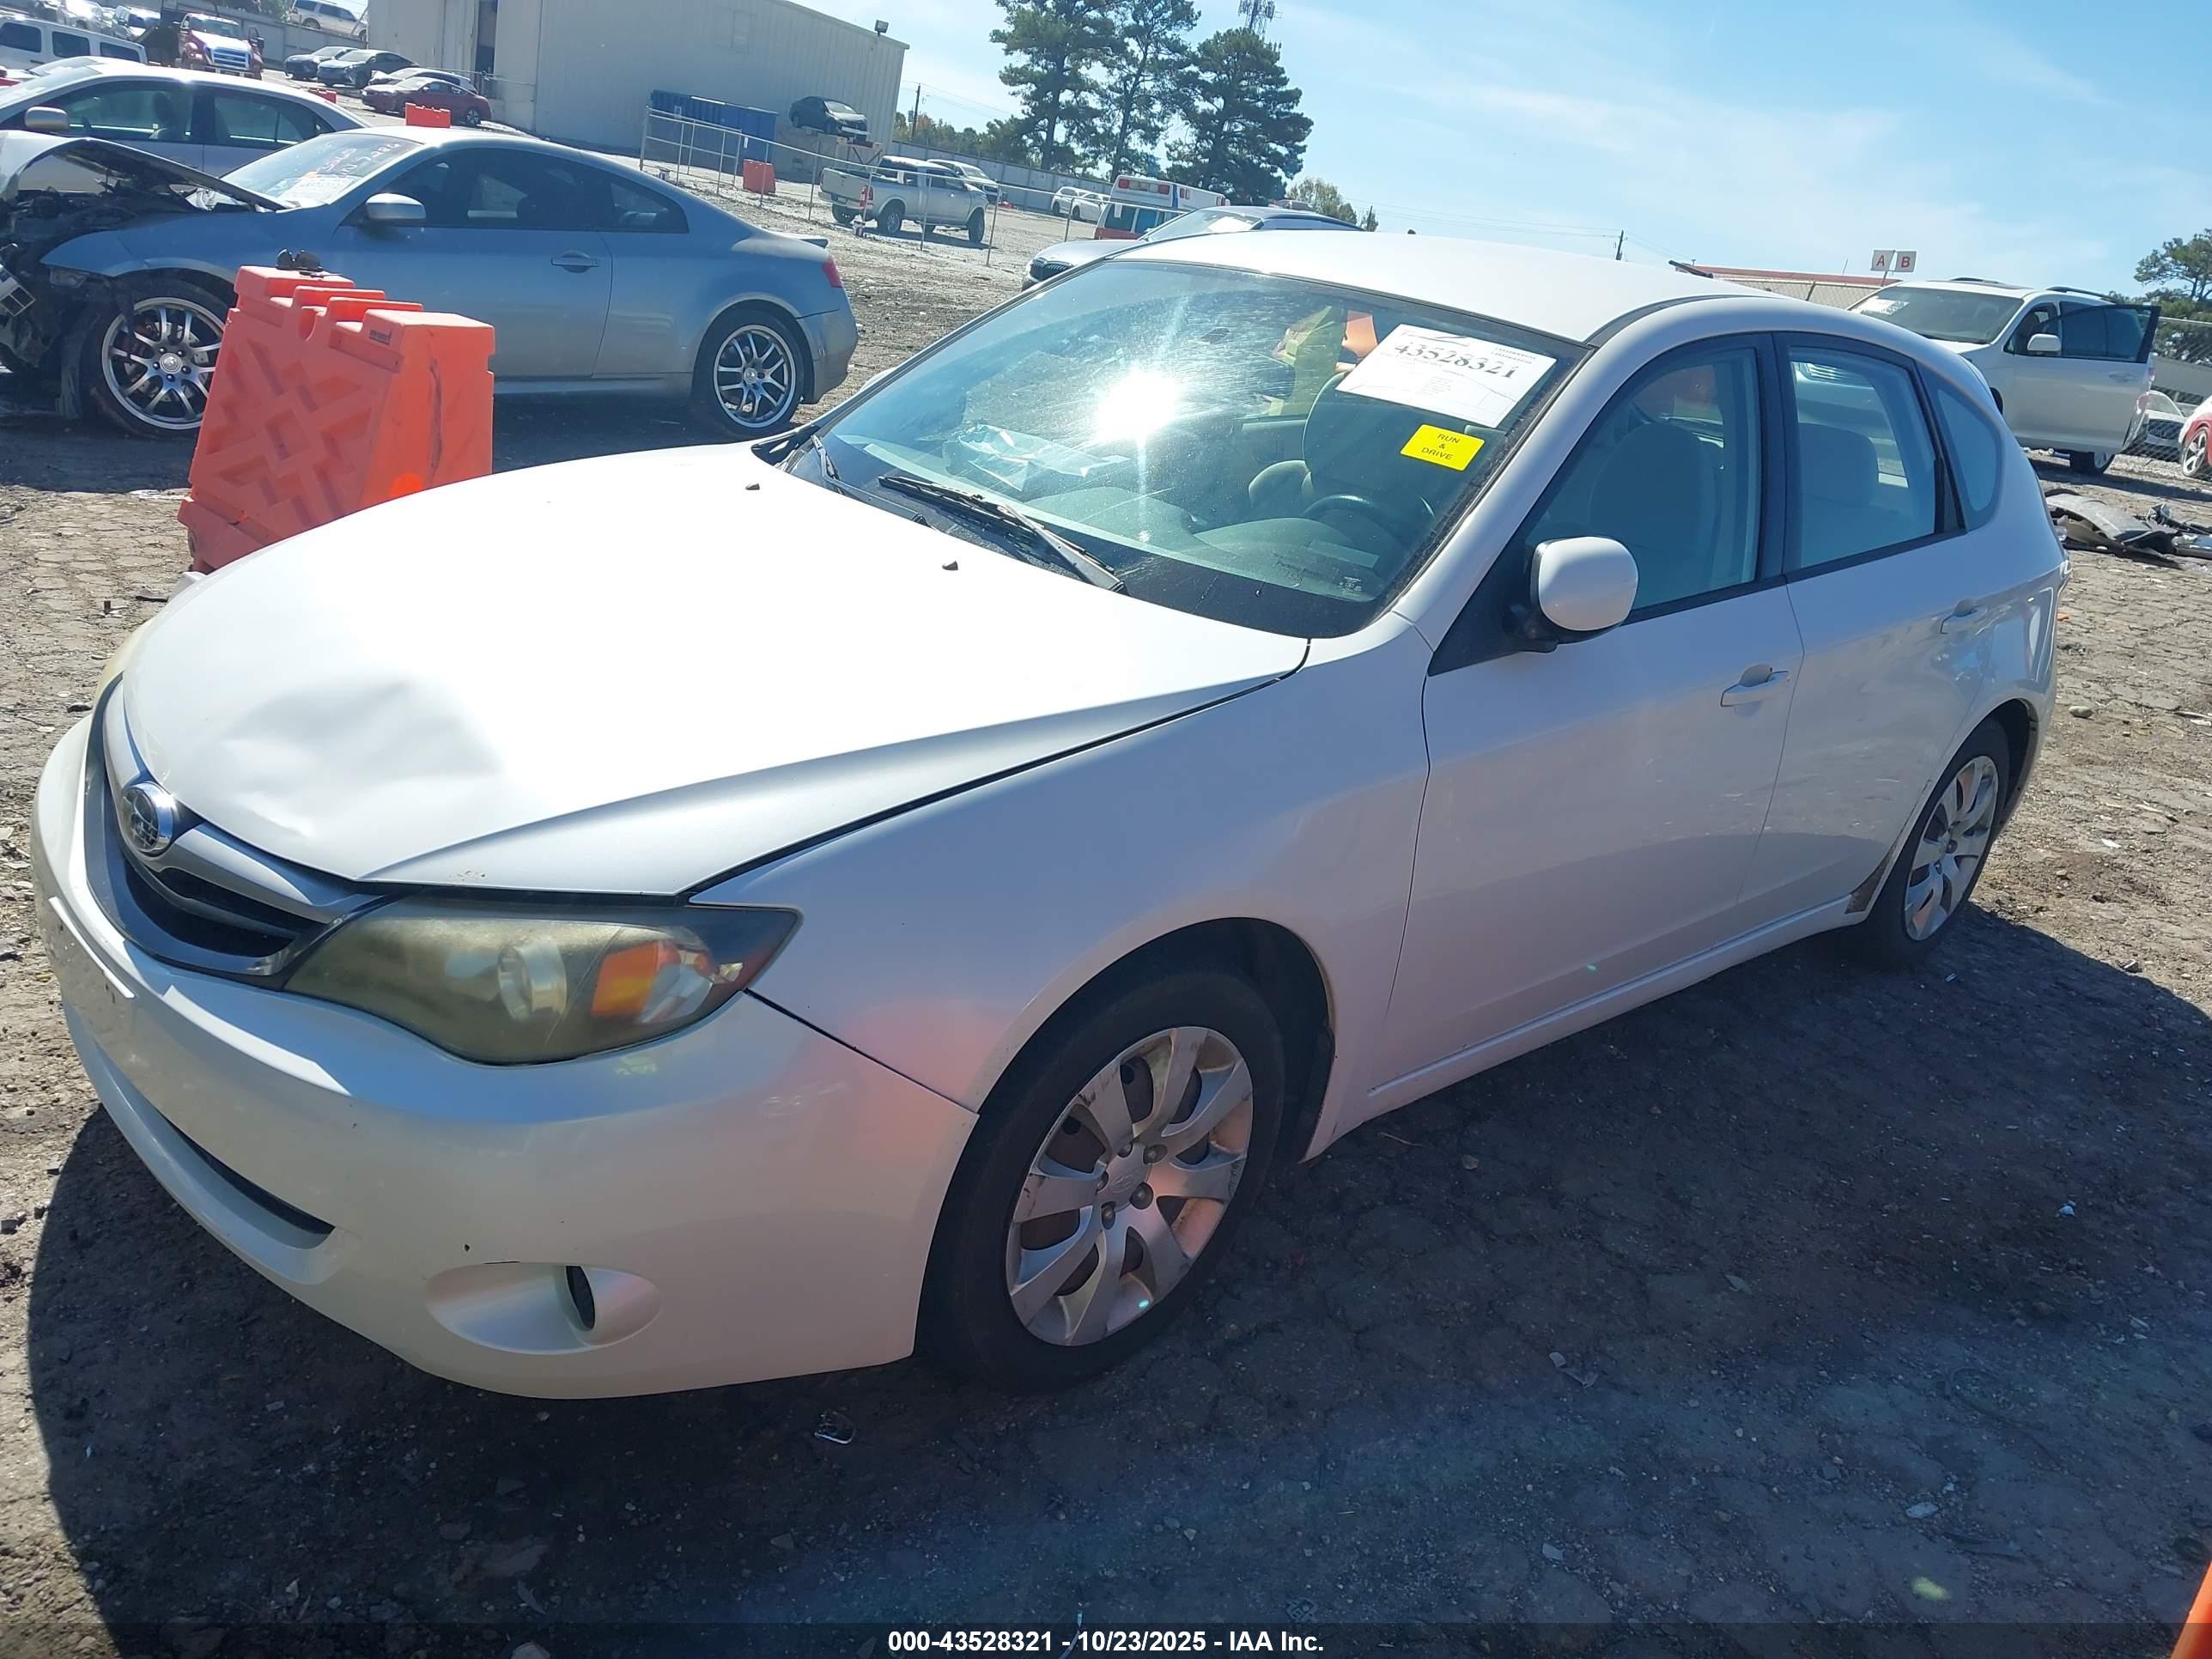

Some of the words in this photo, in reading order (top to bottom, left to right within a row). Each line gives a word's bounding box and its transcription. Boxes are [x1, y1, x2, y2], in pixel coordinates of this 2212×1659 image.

[1876, 255, 1885, 266] A
[1901, 257, 1910, 268] B
[1395, 341, 1519, 380] 43528321
[1437, 434, 1461, 444] RUN
[1421, 447, 1454, 460] DRIVE
